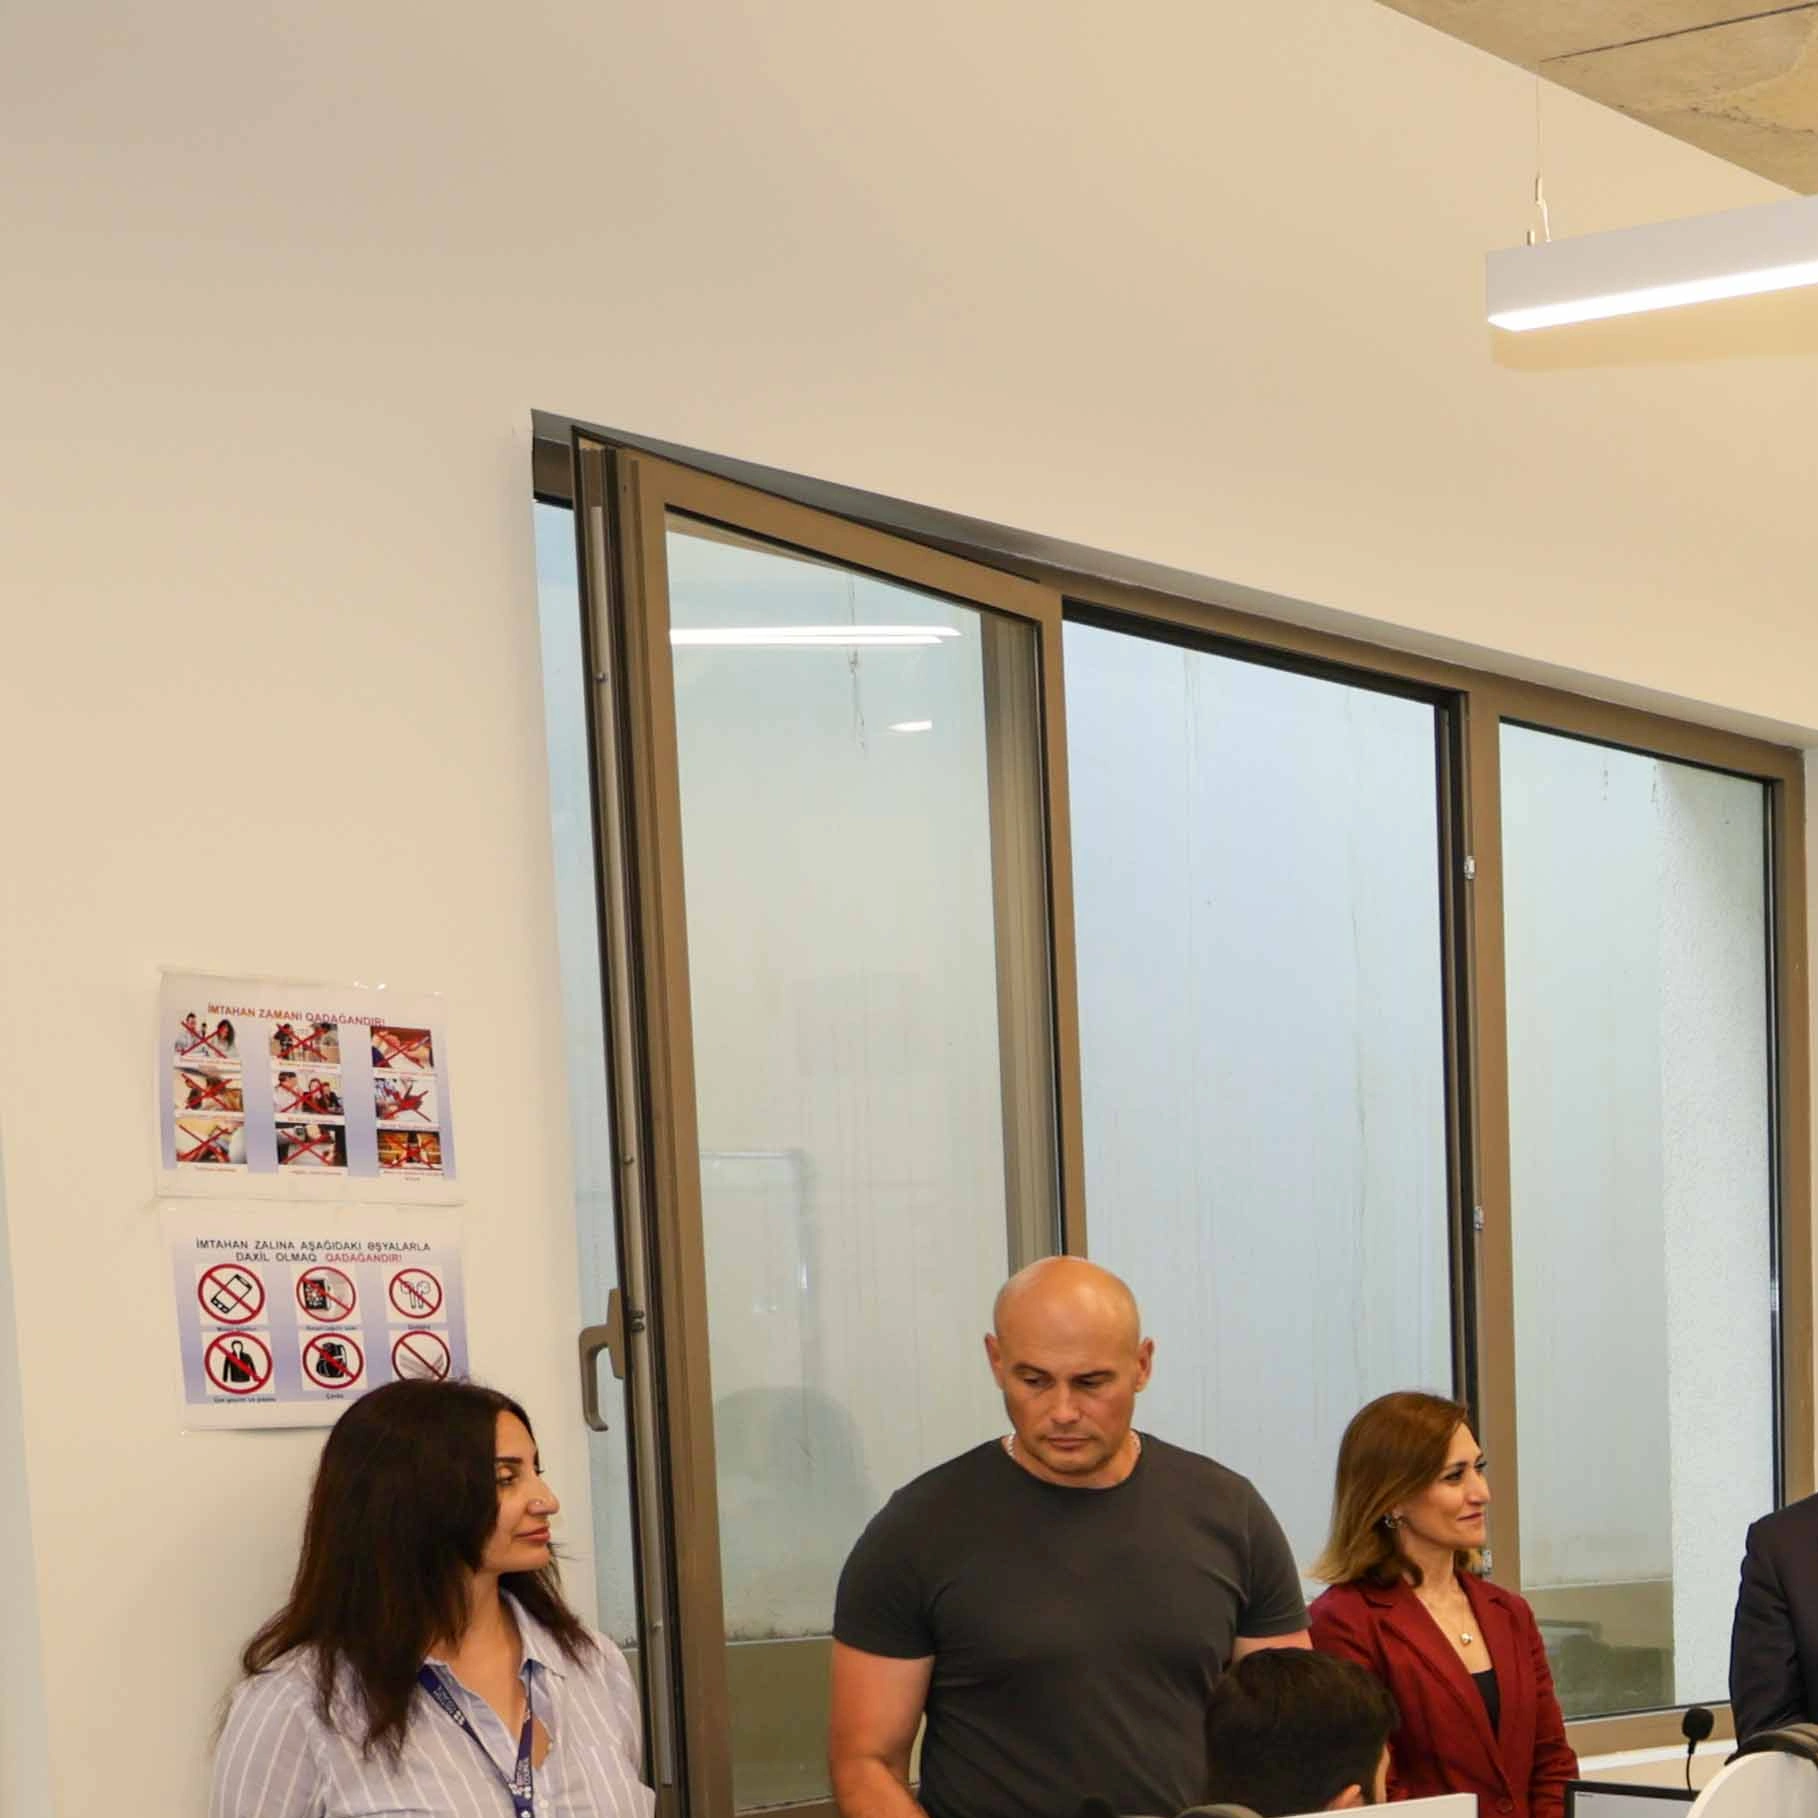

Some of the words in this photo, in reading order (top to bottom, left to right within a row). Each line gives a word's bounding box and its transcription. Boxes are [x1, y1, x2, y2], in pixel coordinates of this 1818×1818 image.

[258, 1007, 302, 1021] ZAMANI
[196, 1236, 249, 1250] İMTAHAN
[254, 1239, 295, 1250] ZALINA
[276, 1252, 318, 1263] OLMAQ
